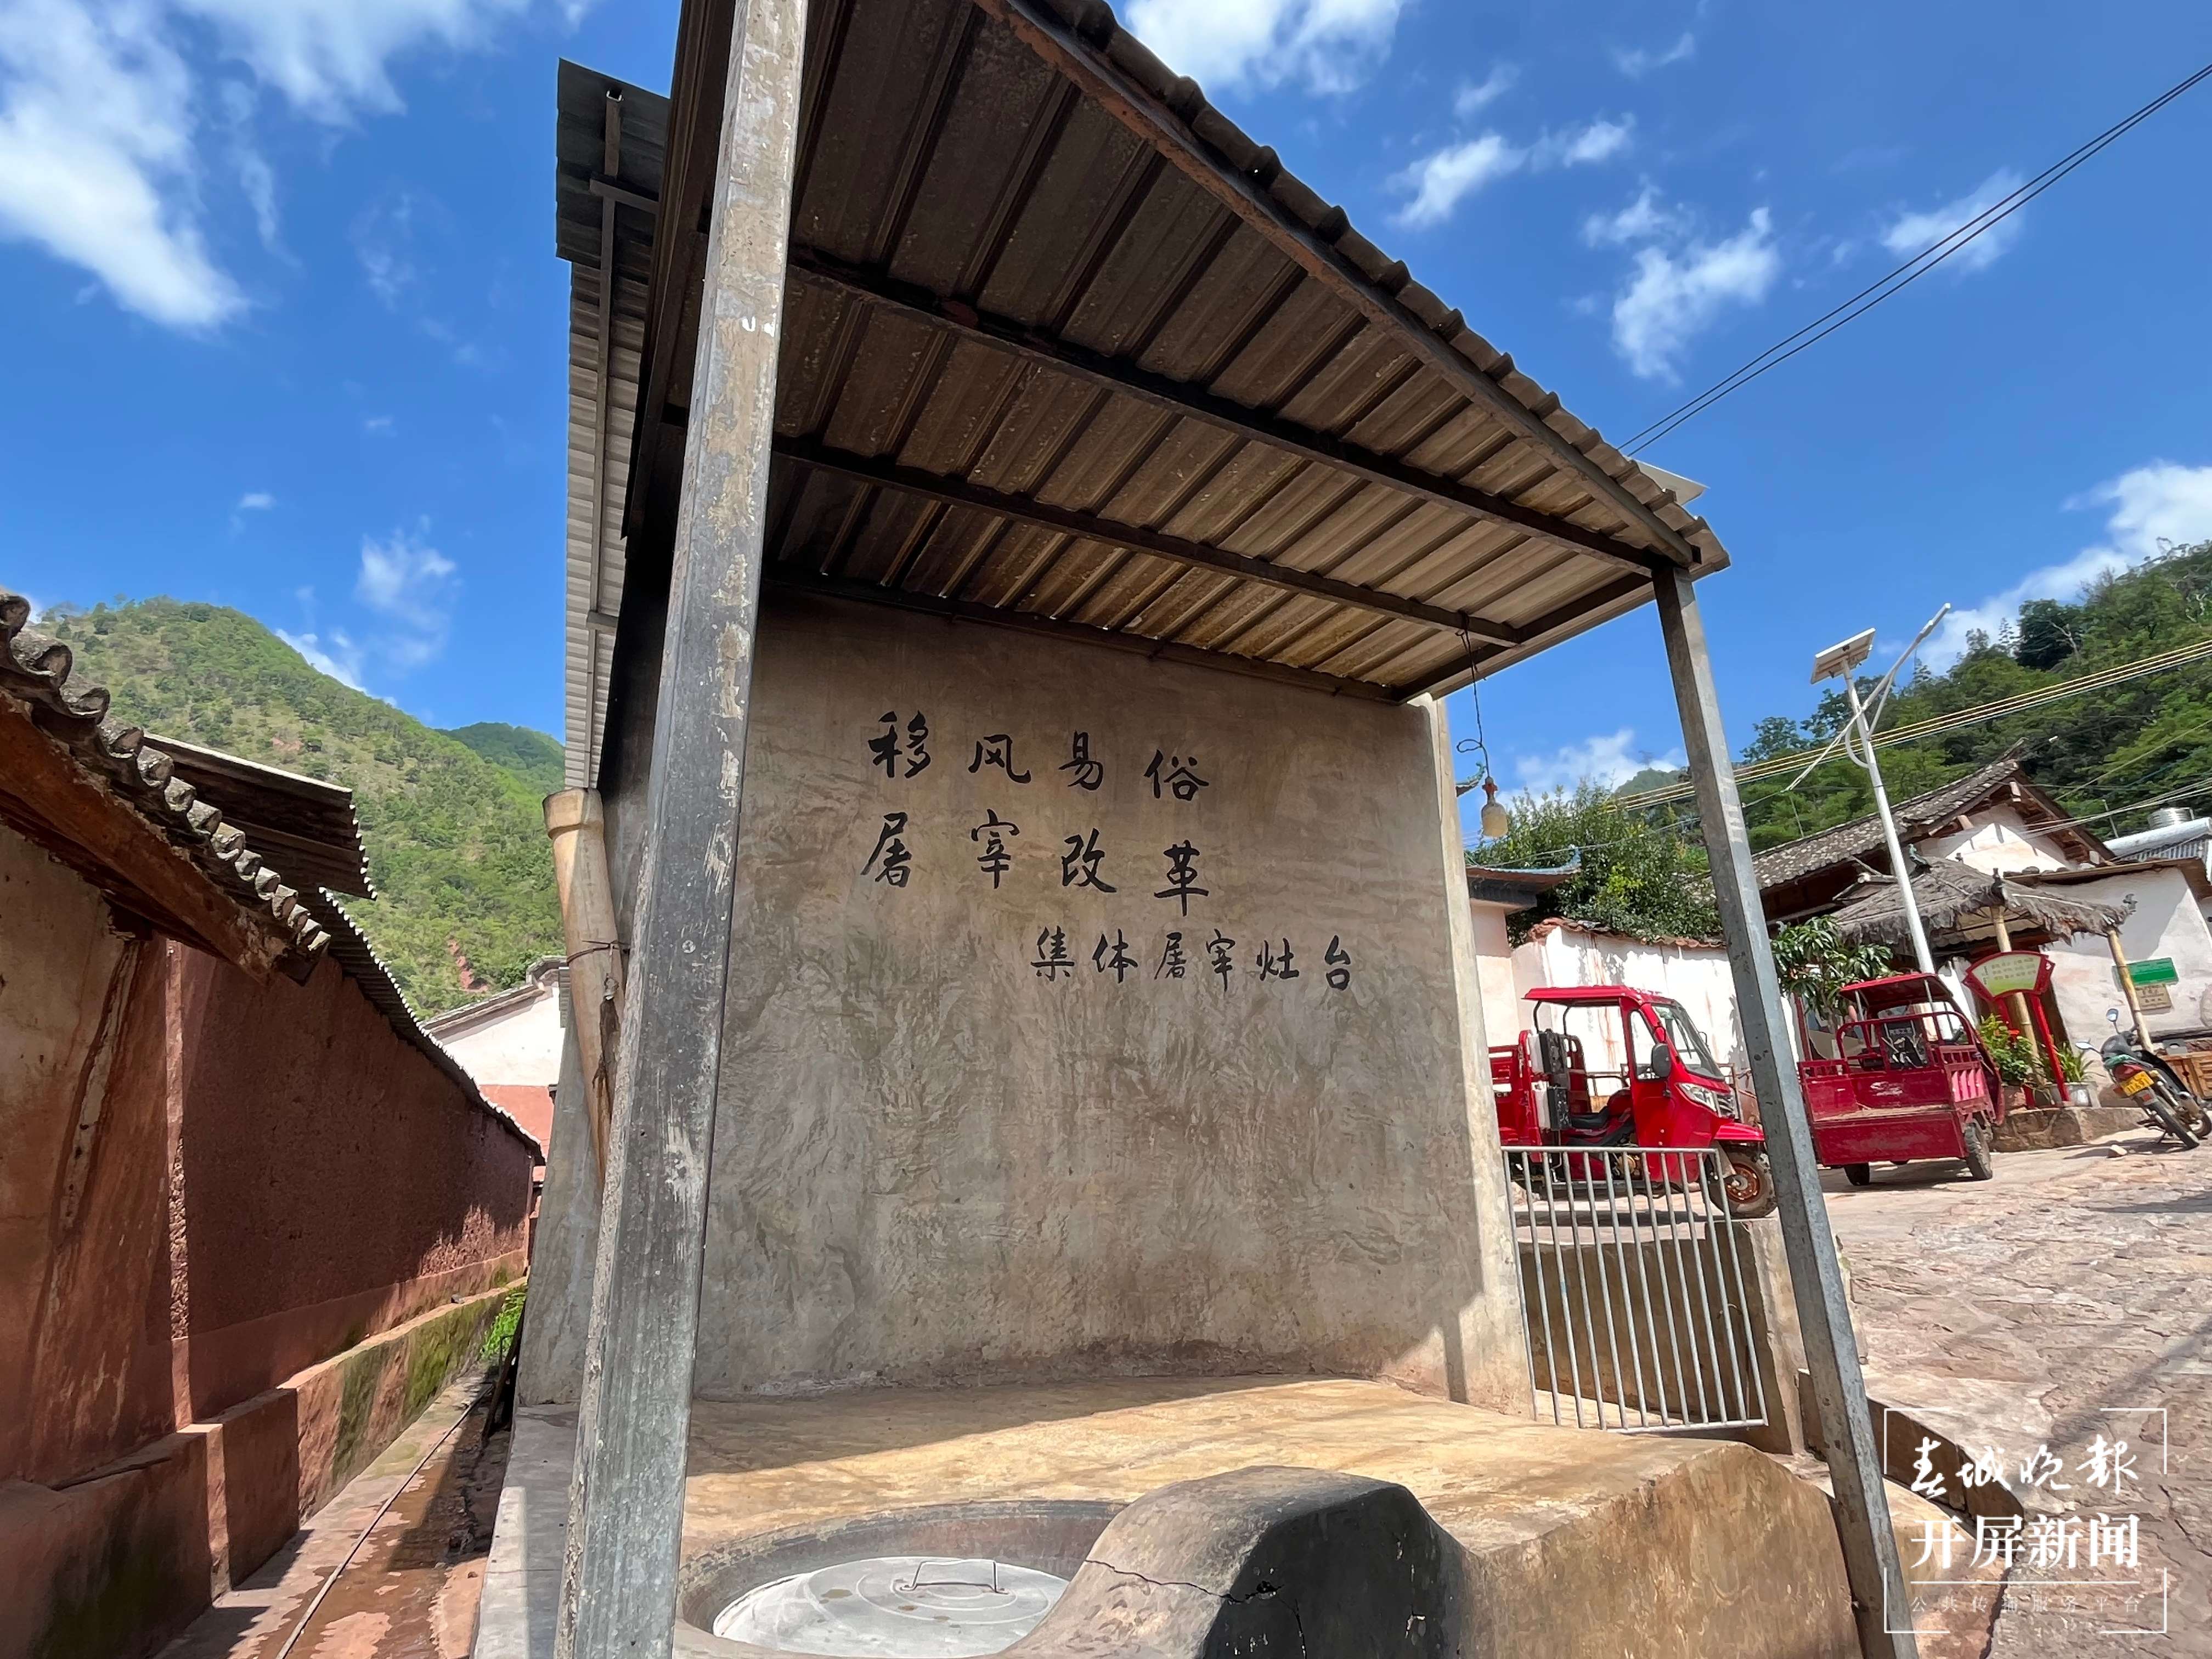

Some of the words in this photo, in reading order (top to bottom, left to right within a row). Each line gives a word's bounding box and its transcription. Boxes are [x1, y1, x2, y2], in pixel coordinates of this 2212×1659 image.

[867, 709, 1210, 802] 移风易俗
[861, 809, 1209, 917] 屠宰改革
[1030, 926, 1351, 992] 集体屠宰灶台
